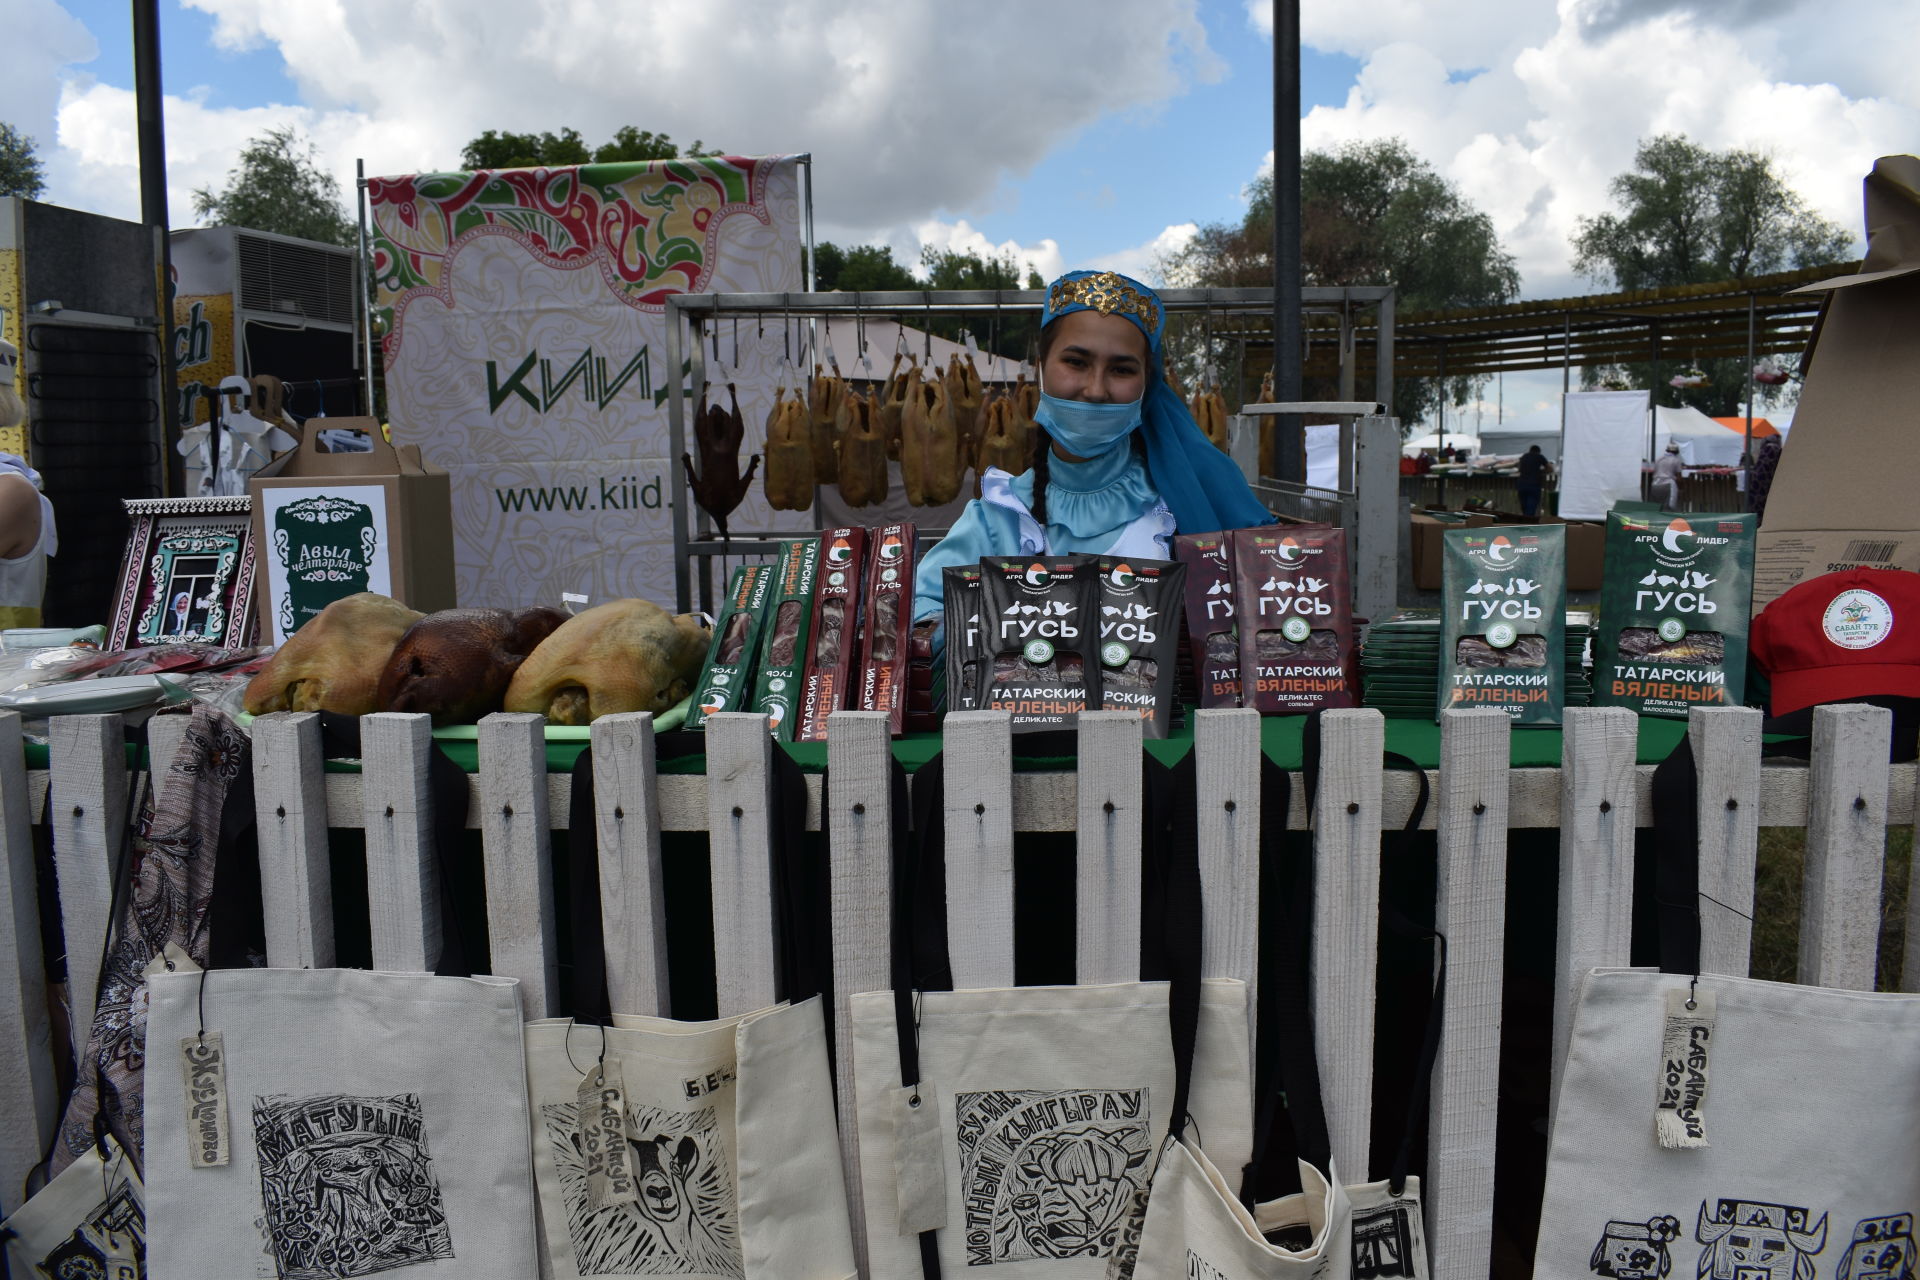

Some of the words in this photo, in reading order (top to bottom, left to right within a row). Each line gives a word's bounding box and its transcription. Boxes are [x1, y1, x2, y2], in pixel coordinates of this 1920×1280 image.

[496, 475, 674, 513] www.kiid.
[1635, 535, 1658, 543] АГРО
[1697, 536, 1728, 545] ЛИДЕР
[300, 544, 351, 561] Авыл
[784, 542, 803, 596] ВЯЛЕНЫЙ
[800, 542, 816, 596] ТАТАРСКИЙ
[750, 567, 770, 609] ТАТАРСКИЙ
[876, 582, 902, 591] ГУСЬ
[1136, 576, 1158, 584] ЛИДЕР
[823, 586, 848, 594] ГУСЬ
[1206, 600, 1234, 620] ГУ
[1260, 597, 1332, 616] ГУСЬ
[1463, 600, 1542, 620] ГУСЬ
[1635, 591, 1717, 614] ГУСЬ
[1001, 620, 1078, 638] ГУСЬ
[1100, 622, 1156, 644] УСЬ
[1835, 624, 1861, 632] САБАН
[710, 667, 738, 675] ГУСЬ
[1256, 666, 1343, 677] ТАТАРСКИЙ
[1453, 674, 1548, 686] ТАТАРСКИЙ
[1614, 665, 1724, 684] ТАТАРСКИЙ
[864, 668, 876, 711] АРСКИЙ
[877, 666, 892, 711] ЛЕНЫЙ
[992, 688, 1086, 699] ТАТАРСКИЙ
[1256, 678, 1344, 692] ВЯЛЕНЫЙ
[1612, 680, 1724, 703] ВЯЛЕНЫЙ
[1104, 690, 1156, 706] РСКИЙ
[1452, 688, 1548, 702] ВЯЛЕНЫЙ
[802, 675, 818, 740] ТАТАРСКИЙ
[815, 673, 834, 740] ВЯЛЕНЫЙ
[991, 700, 1086, 714] ВЯЛЕНЫЙ
[1659, 1060, 1685, 1110] 2021
[260, 1102, 422, 1164] МАТУРЫМ
[584, 1124, 604, 1176] 2021
